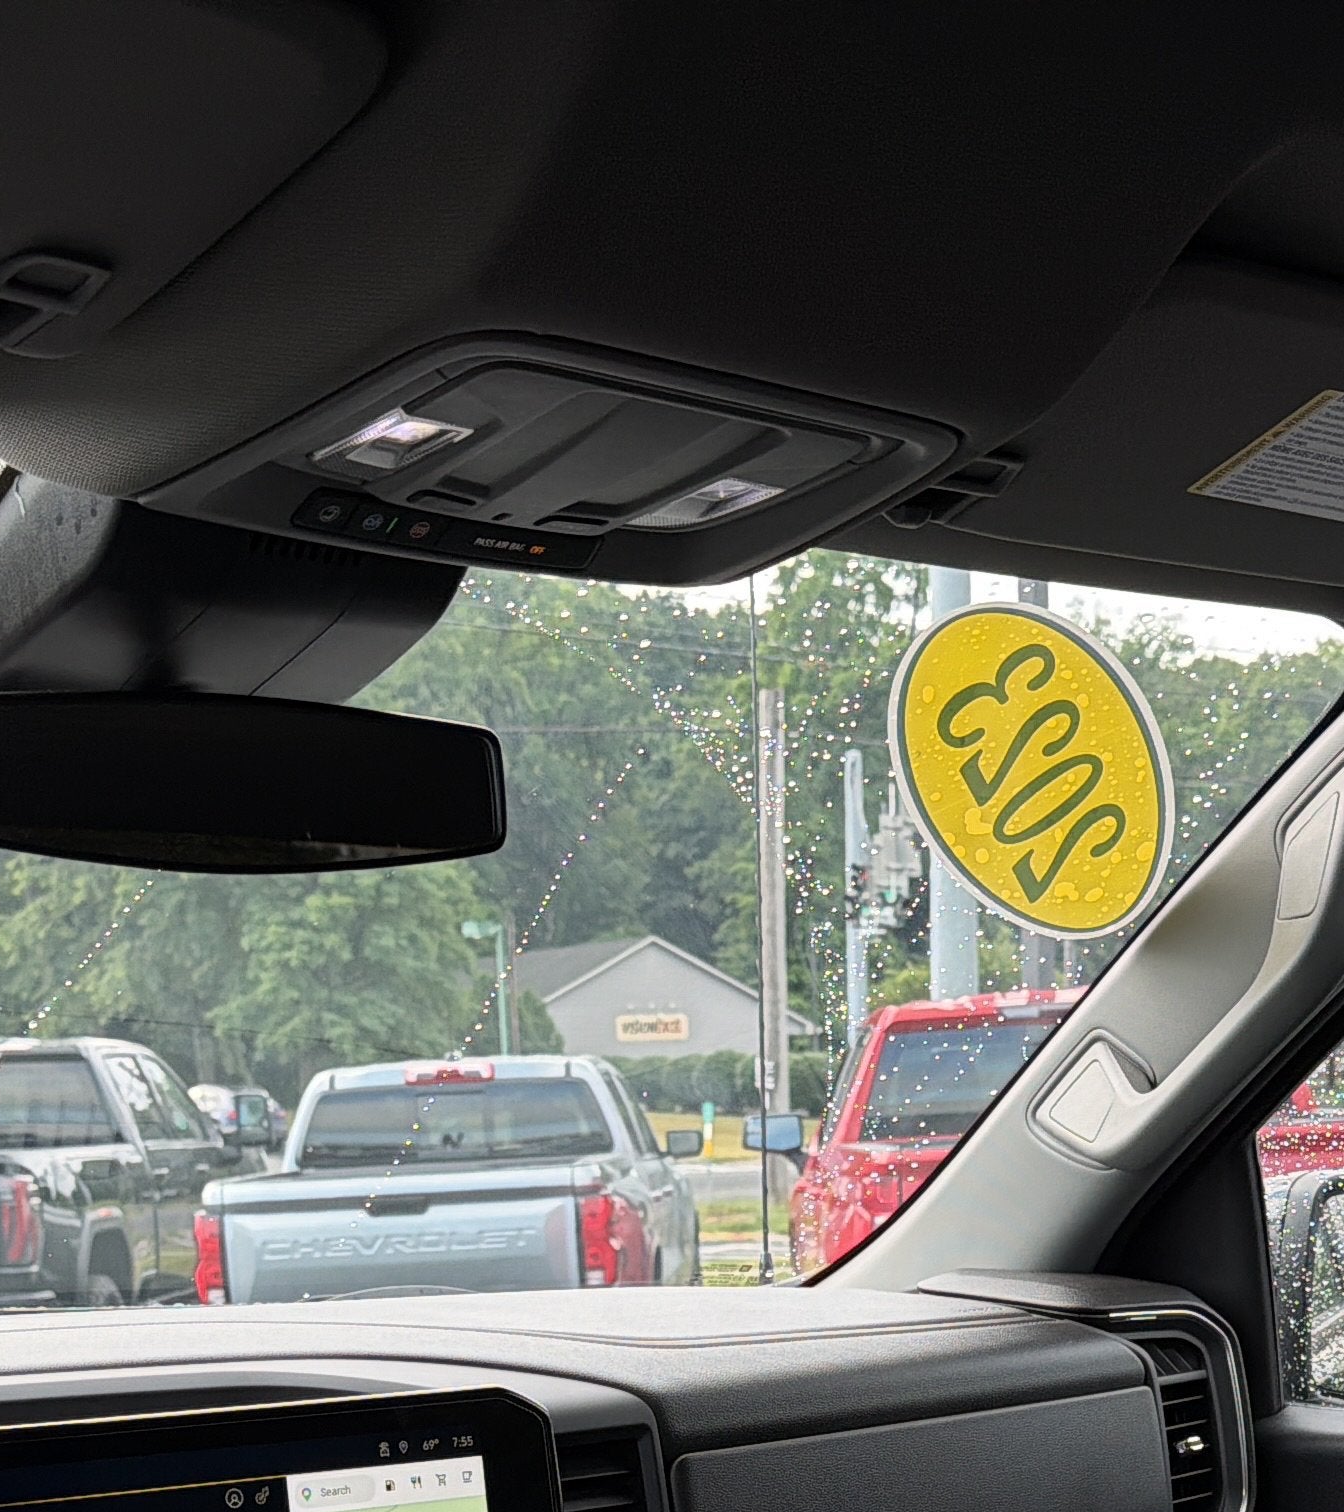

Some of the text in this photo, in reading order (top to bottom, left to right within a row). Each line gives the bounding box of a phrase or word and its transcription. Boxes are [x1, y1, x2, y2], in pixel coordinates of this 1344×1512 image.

[474, 537, 496, 548] PASS
[495, 540, 510, 549] AIR
[261, 1229, 537, 1262] CHEVROLET
[451, 1436, 473, 1448] 7:55
[320, 1485, 352, 1498] Search
